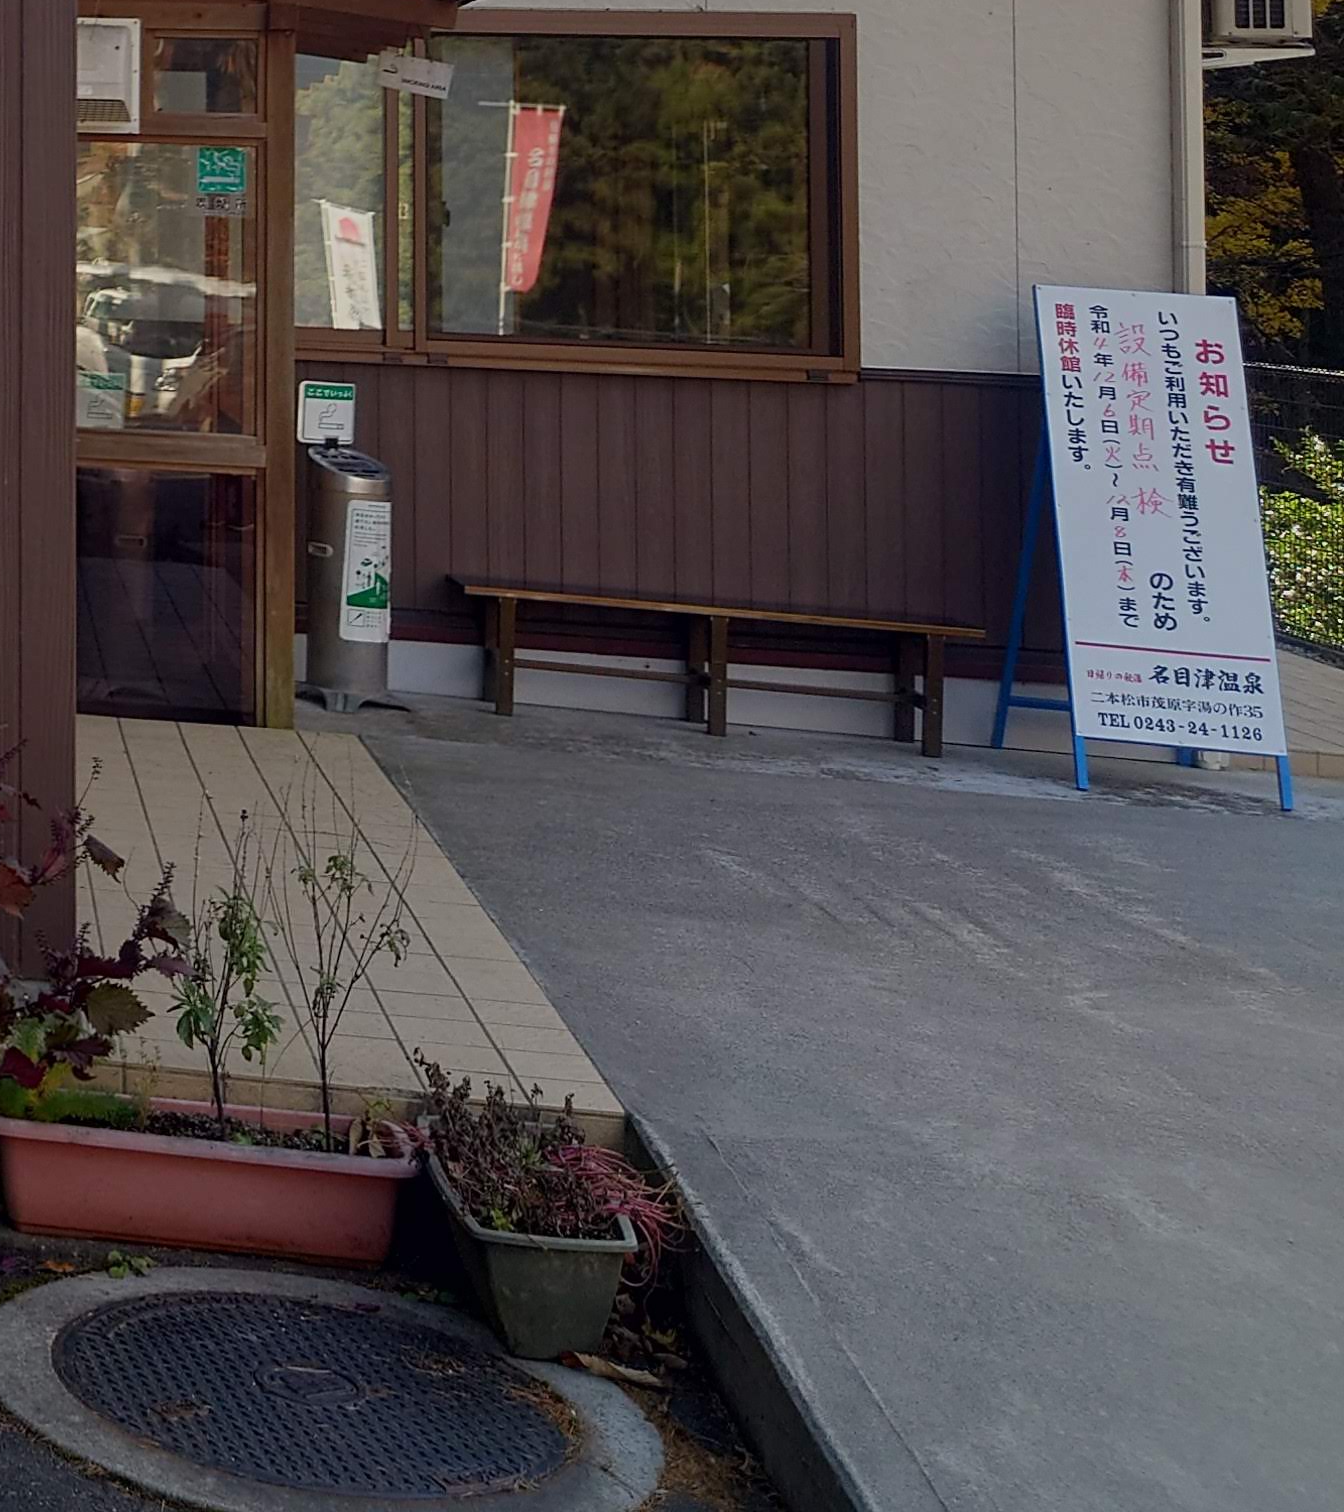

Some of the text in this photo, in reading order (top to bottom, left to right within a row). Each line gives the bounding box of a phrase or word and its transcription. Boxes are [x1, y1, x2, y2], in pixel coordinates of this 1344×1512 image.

[1055, 303, 1092, 471] 臨時休館いたします。
[1194, 339, 1236, 466] お知らせ
[1158, 311, 1211, 623] いつもご利用いただき有難うございます。
[1149, 572, 1178, 632] のため
[1148, 664, 1265, 695] 名目津温泉
[1098, 712, 1263, 742] TEL 0243-24-1126
